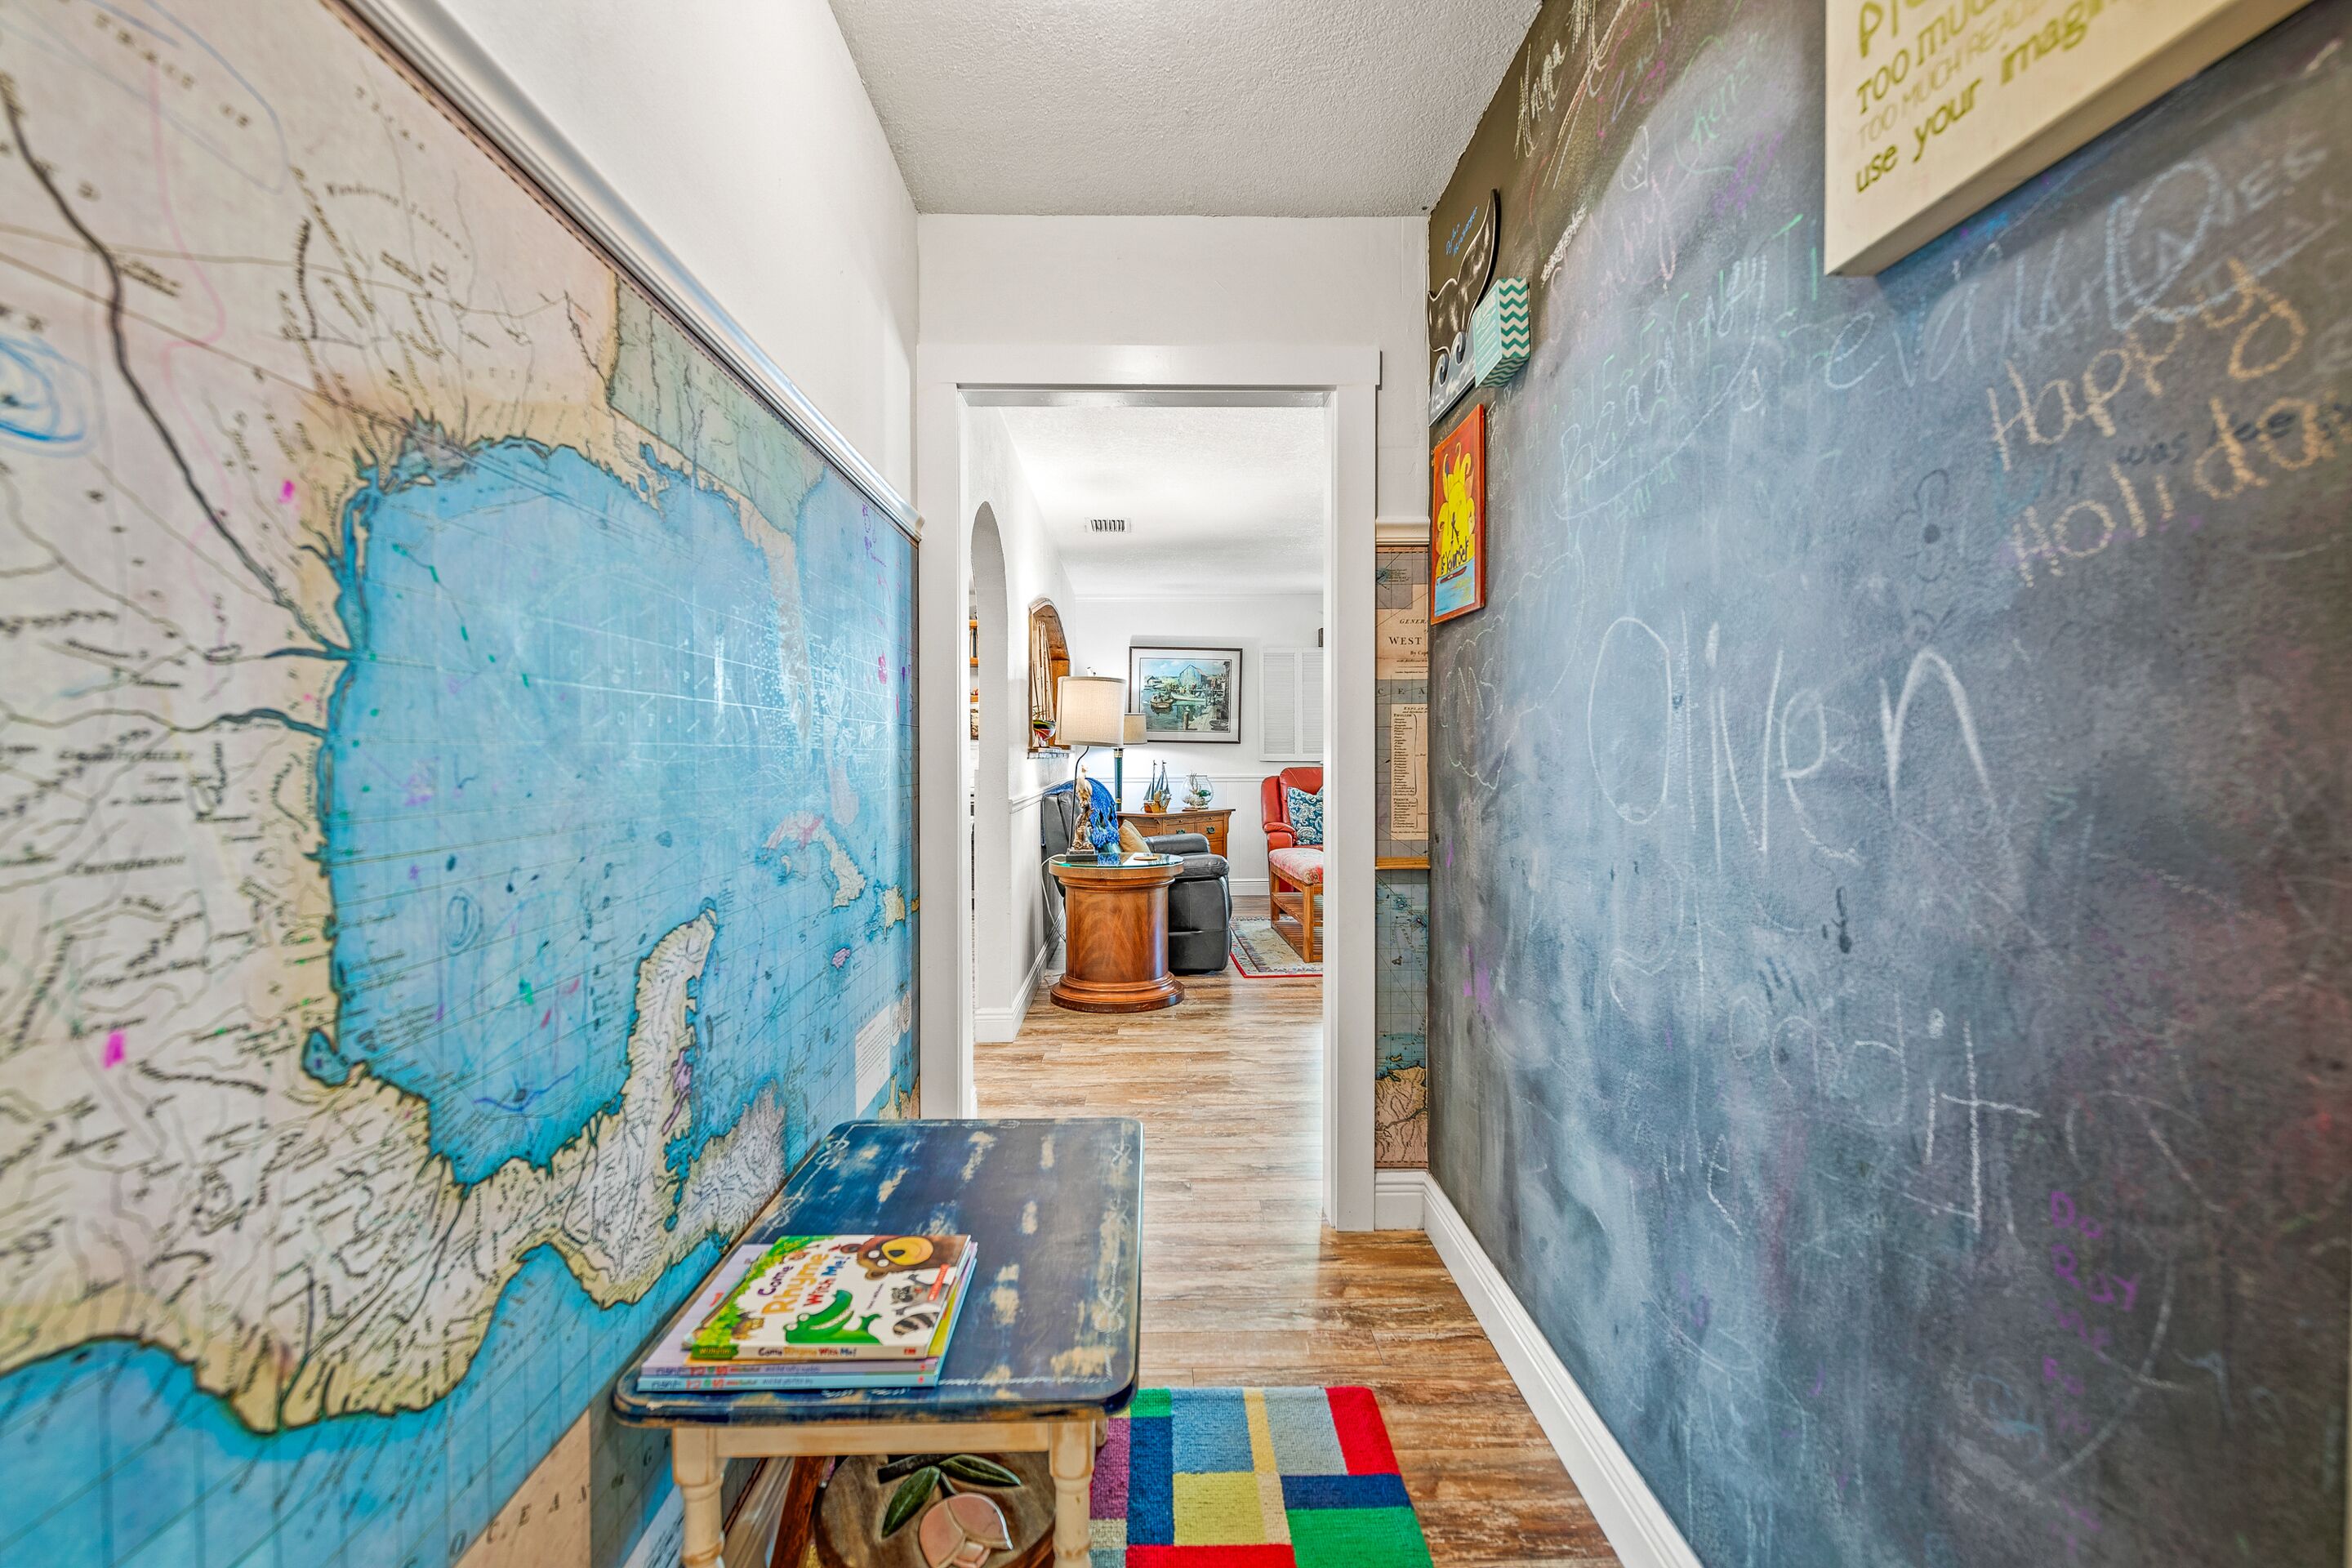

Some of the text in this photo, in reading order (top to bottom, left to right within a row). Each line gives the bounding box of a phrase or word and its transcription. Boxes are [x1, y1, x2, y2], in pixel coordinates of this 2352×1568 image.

[1856, 49, 1909, 115] TOO
[1857, 104, 1897, 148] TOO
[1902, 50, 1962, 117] MUCH
[1855, 144, 1898, 194] use
[1913, 78, 1984, 163] your
[1987, 258, 2306, 470] Happy
[1388, 636, 1422, 645] WEST
[757, 1265, 794, 1296] Come
[760, 1253, 831, 1316] Rhyme
[803, 1276, 836, 1307] With
[758, 1348, 782, 1356] Come
